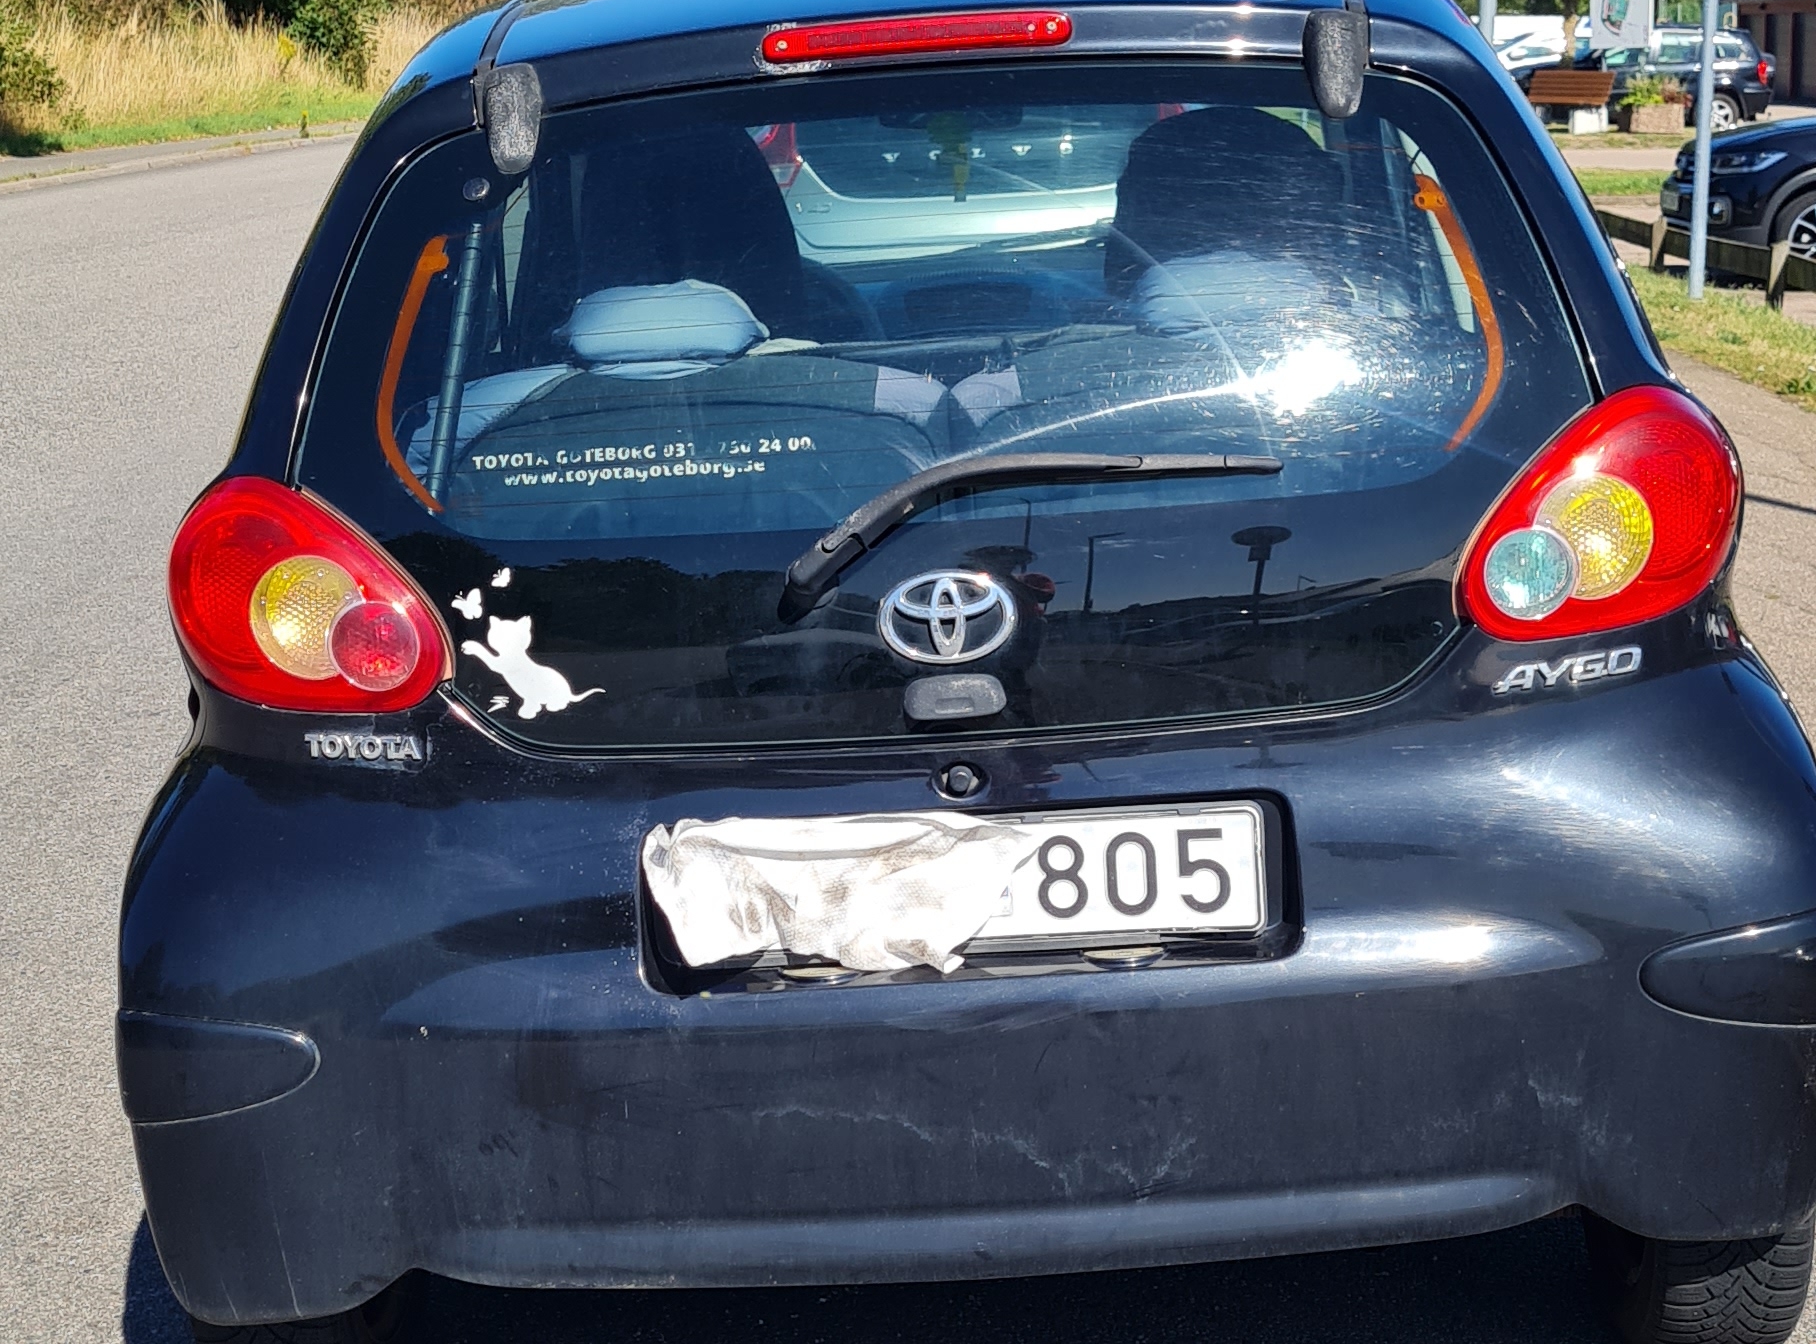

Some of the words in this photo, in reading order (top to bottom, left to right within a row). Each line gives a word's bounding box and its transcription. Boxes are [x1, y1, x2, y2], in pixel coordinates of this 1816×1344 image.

[472, 452, 549, 470] TOYOTA
[663, 442, 696, 458] 031
[758, 438, 782, 454] 24
[788, 436, 814, 452] 00
[1492, 646, 1642, 695] AYGO
[304, 733, 422, 761] TOYOTA
[1037, 827, 1231, 919] 805
